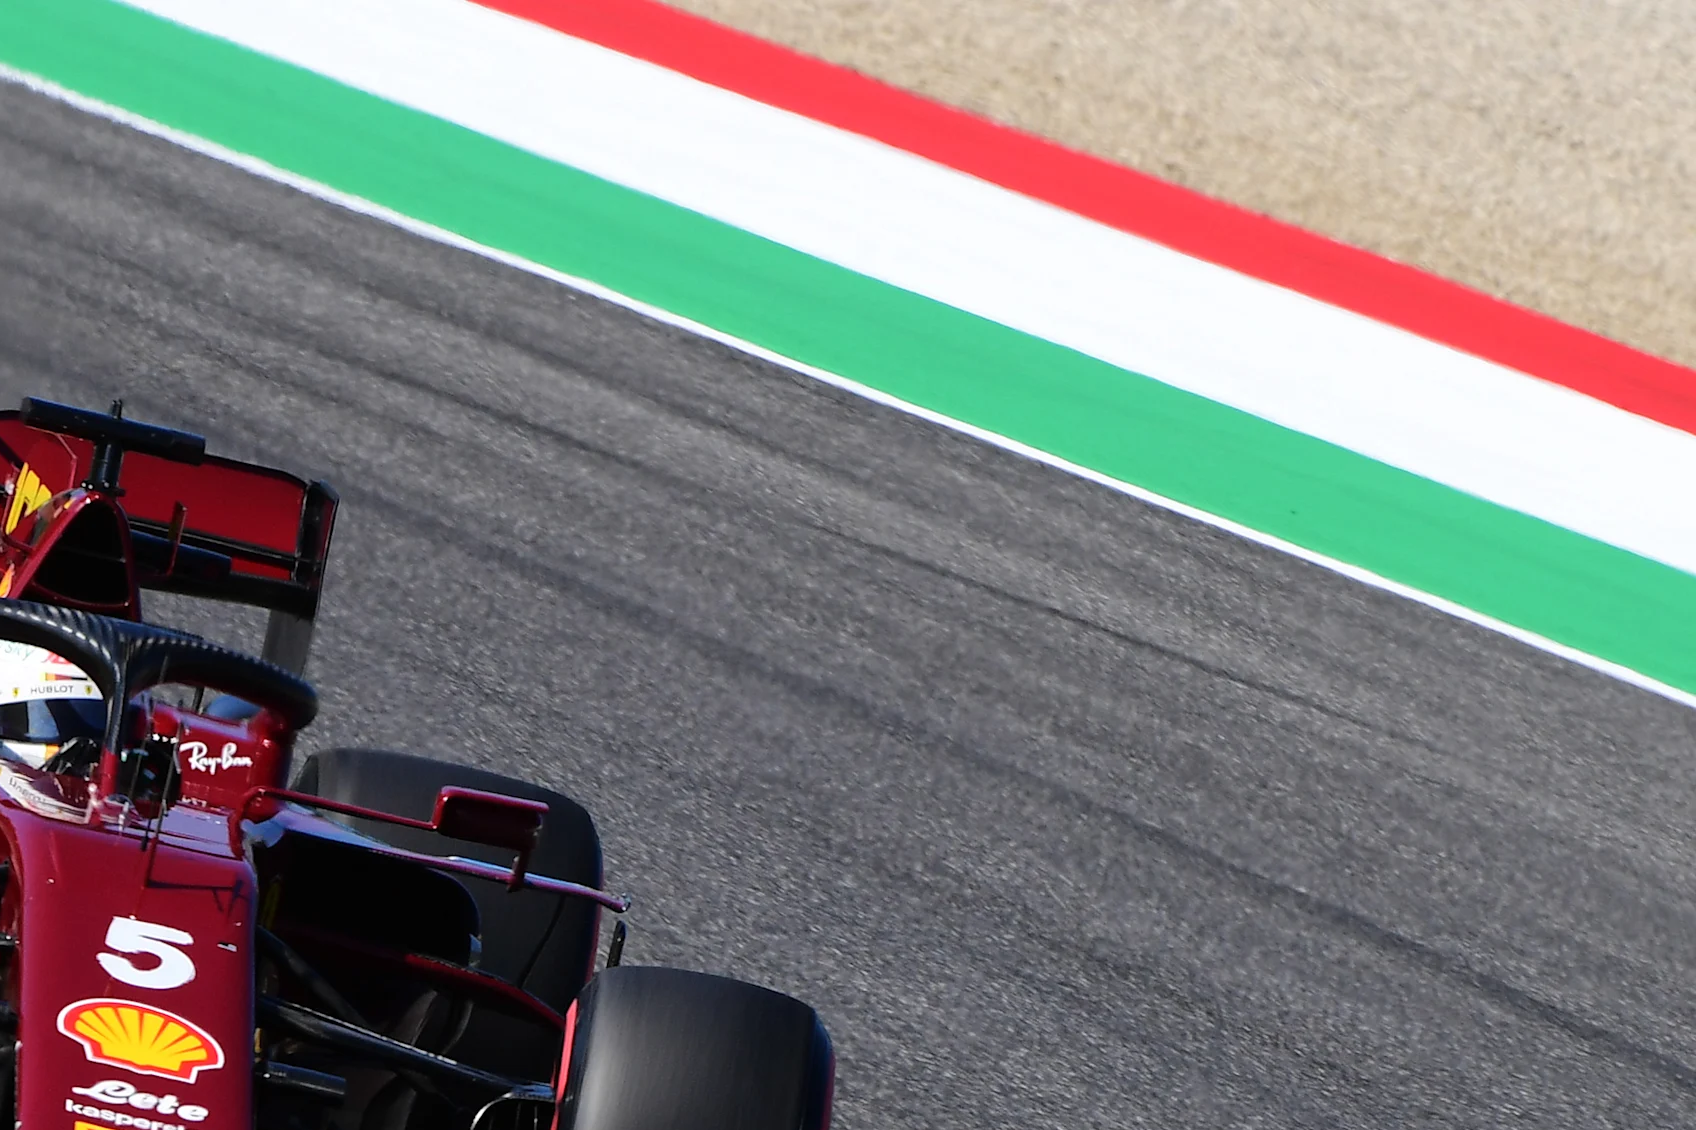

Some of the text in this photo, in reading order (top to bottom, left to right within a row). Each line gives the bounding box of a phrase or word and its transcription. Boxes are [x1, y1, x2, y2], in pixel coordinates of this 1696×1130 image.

[30, 685, 74, 694] HUBLOT
[179, 741, 253, 775] Ray-Ban
[96, 915, 196, 989] 5
[72, 1079, 209, 1122] Lete
